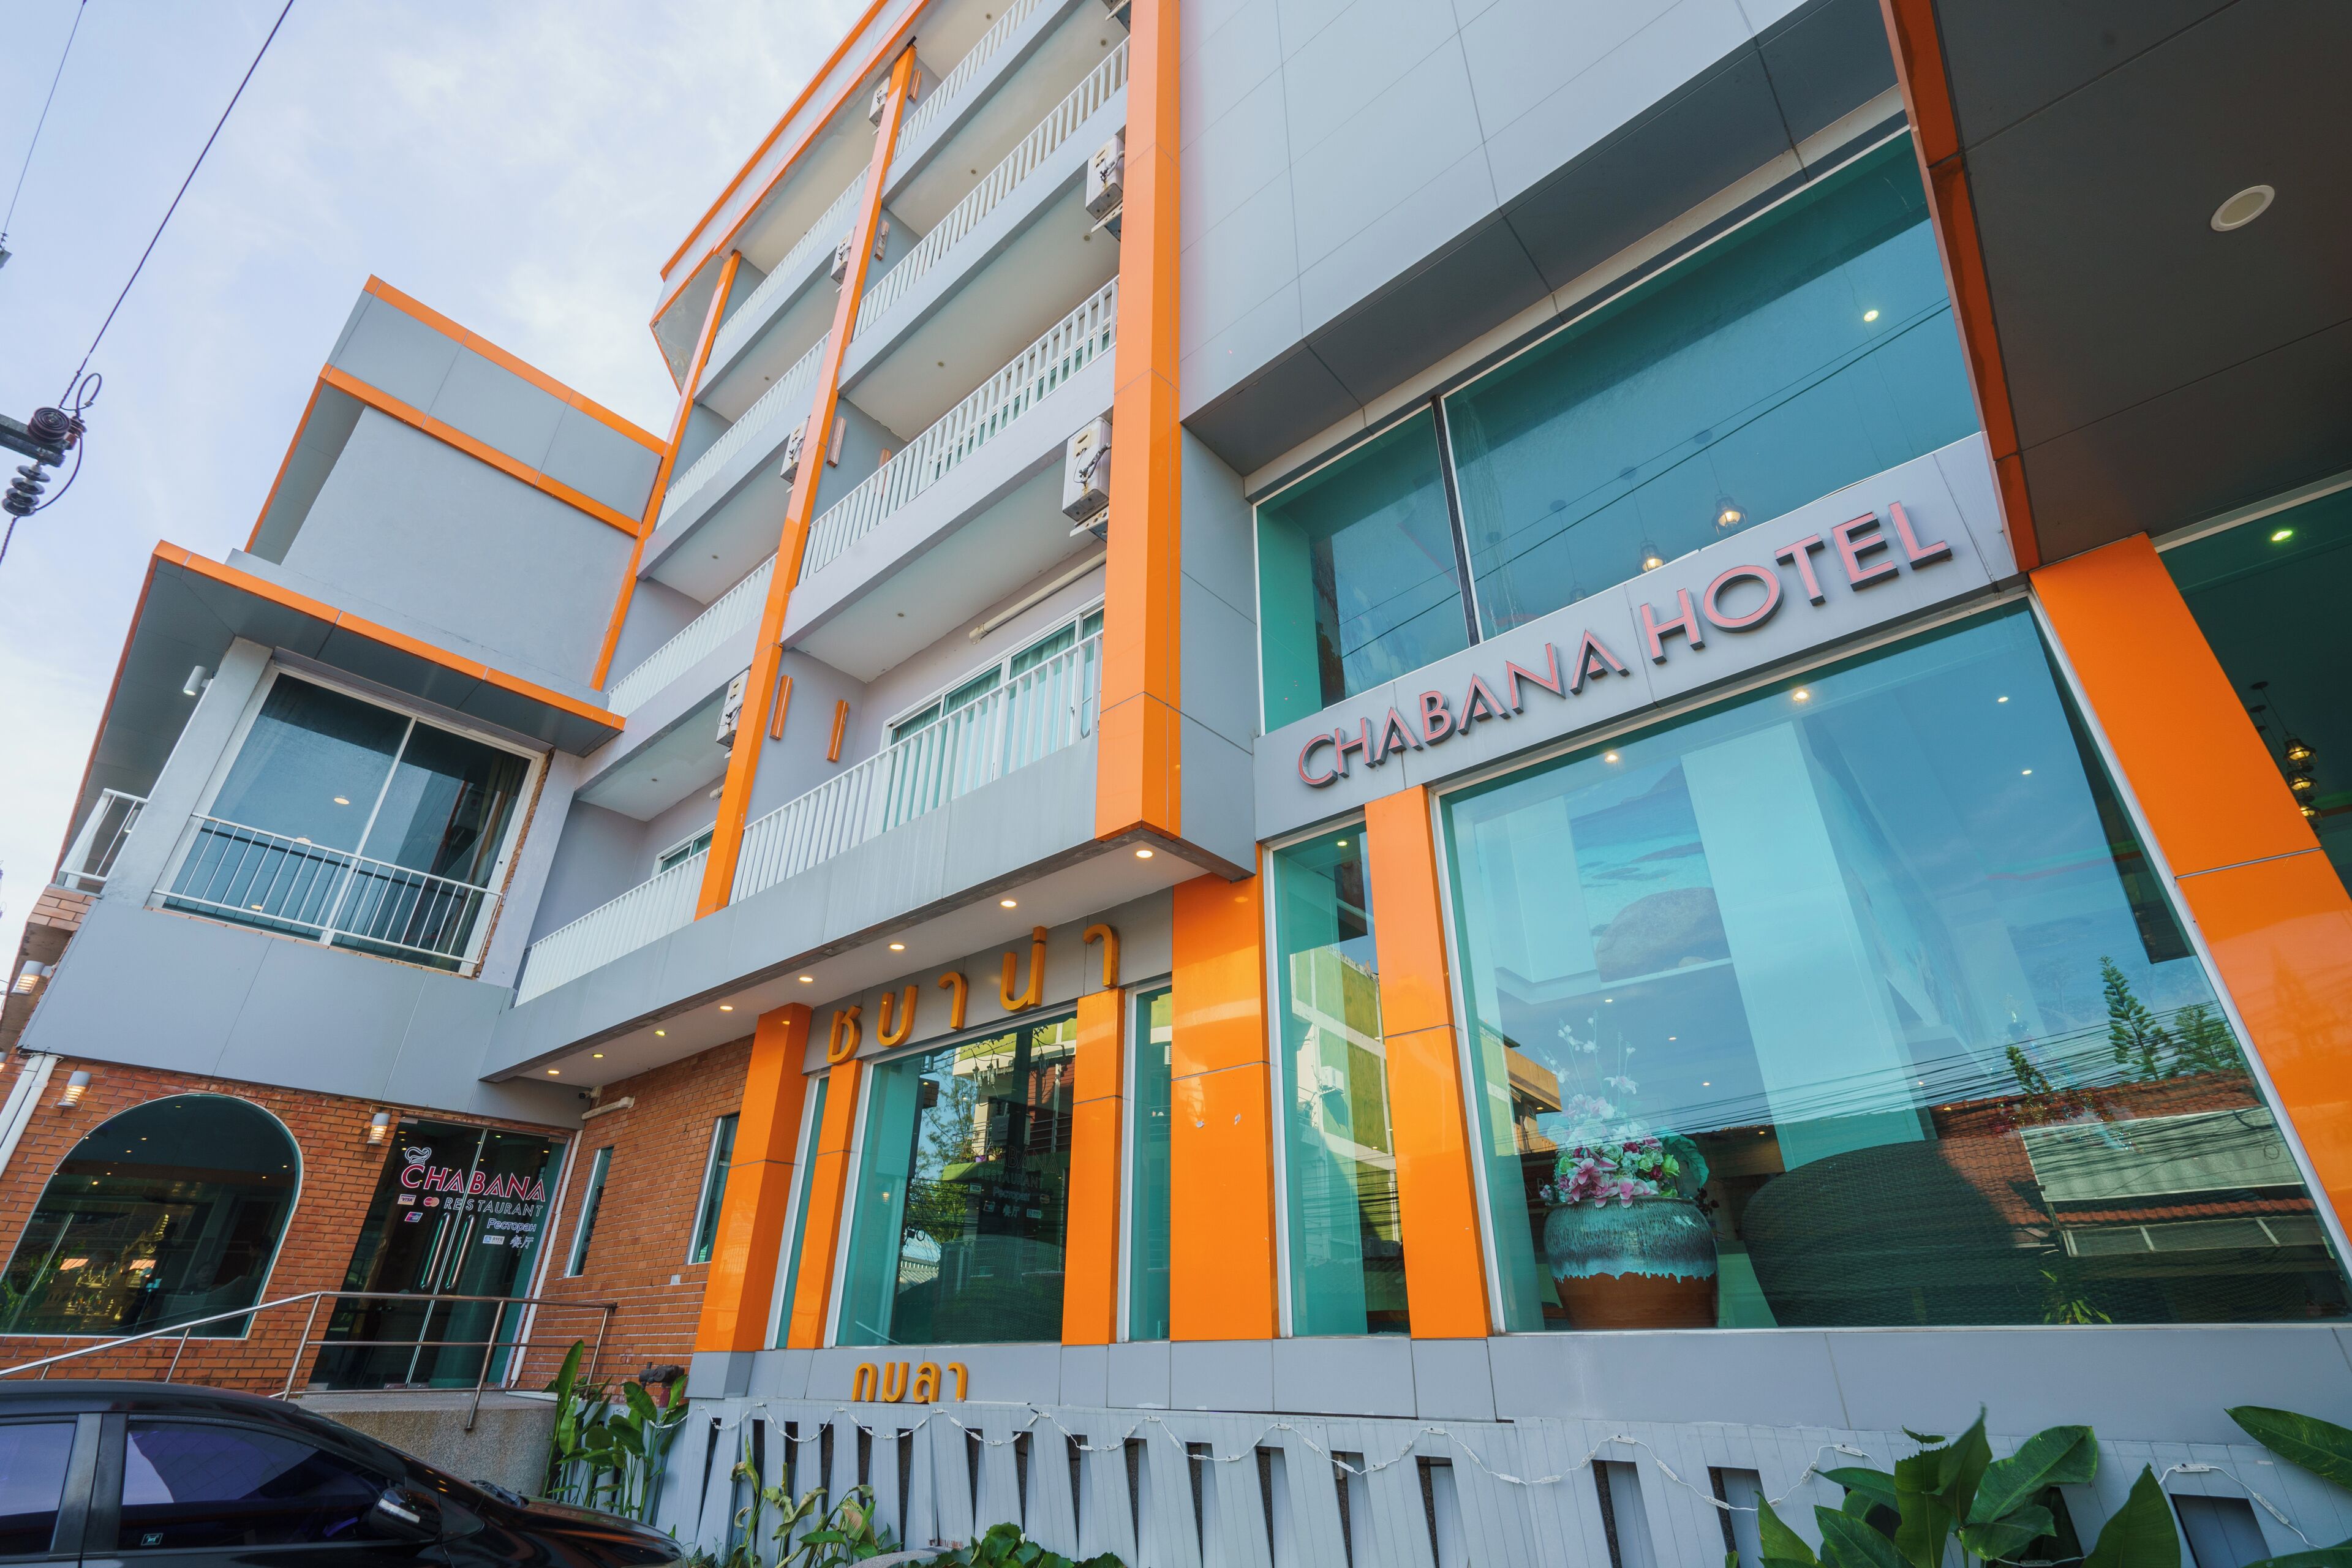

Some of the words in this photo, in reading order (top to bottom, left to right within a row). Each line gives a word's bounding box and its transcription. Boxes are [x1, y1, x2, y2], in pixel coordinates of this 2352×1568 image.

[1297, 629, 1629, 790] CHABANA
[1639, 502, 1951, 665] HOTEL
[401, 1164, 545, 1202] CHABANA
[444, 1197, 543, 1217] RESTAURANT
[487, 1218, 537, 1233] Ресторан
[510, 1235, 534, 1250] 餐厅
[851, 1362, 968, 1403] กมลา
